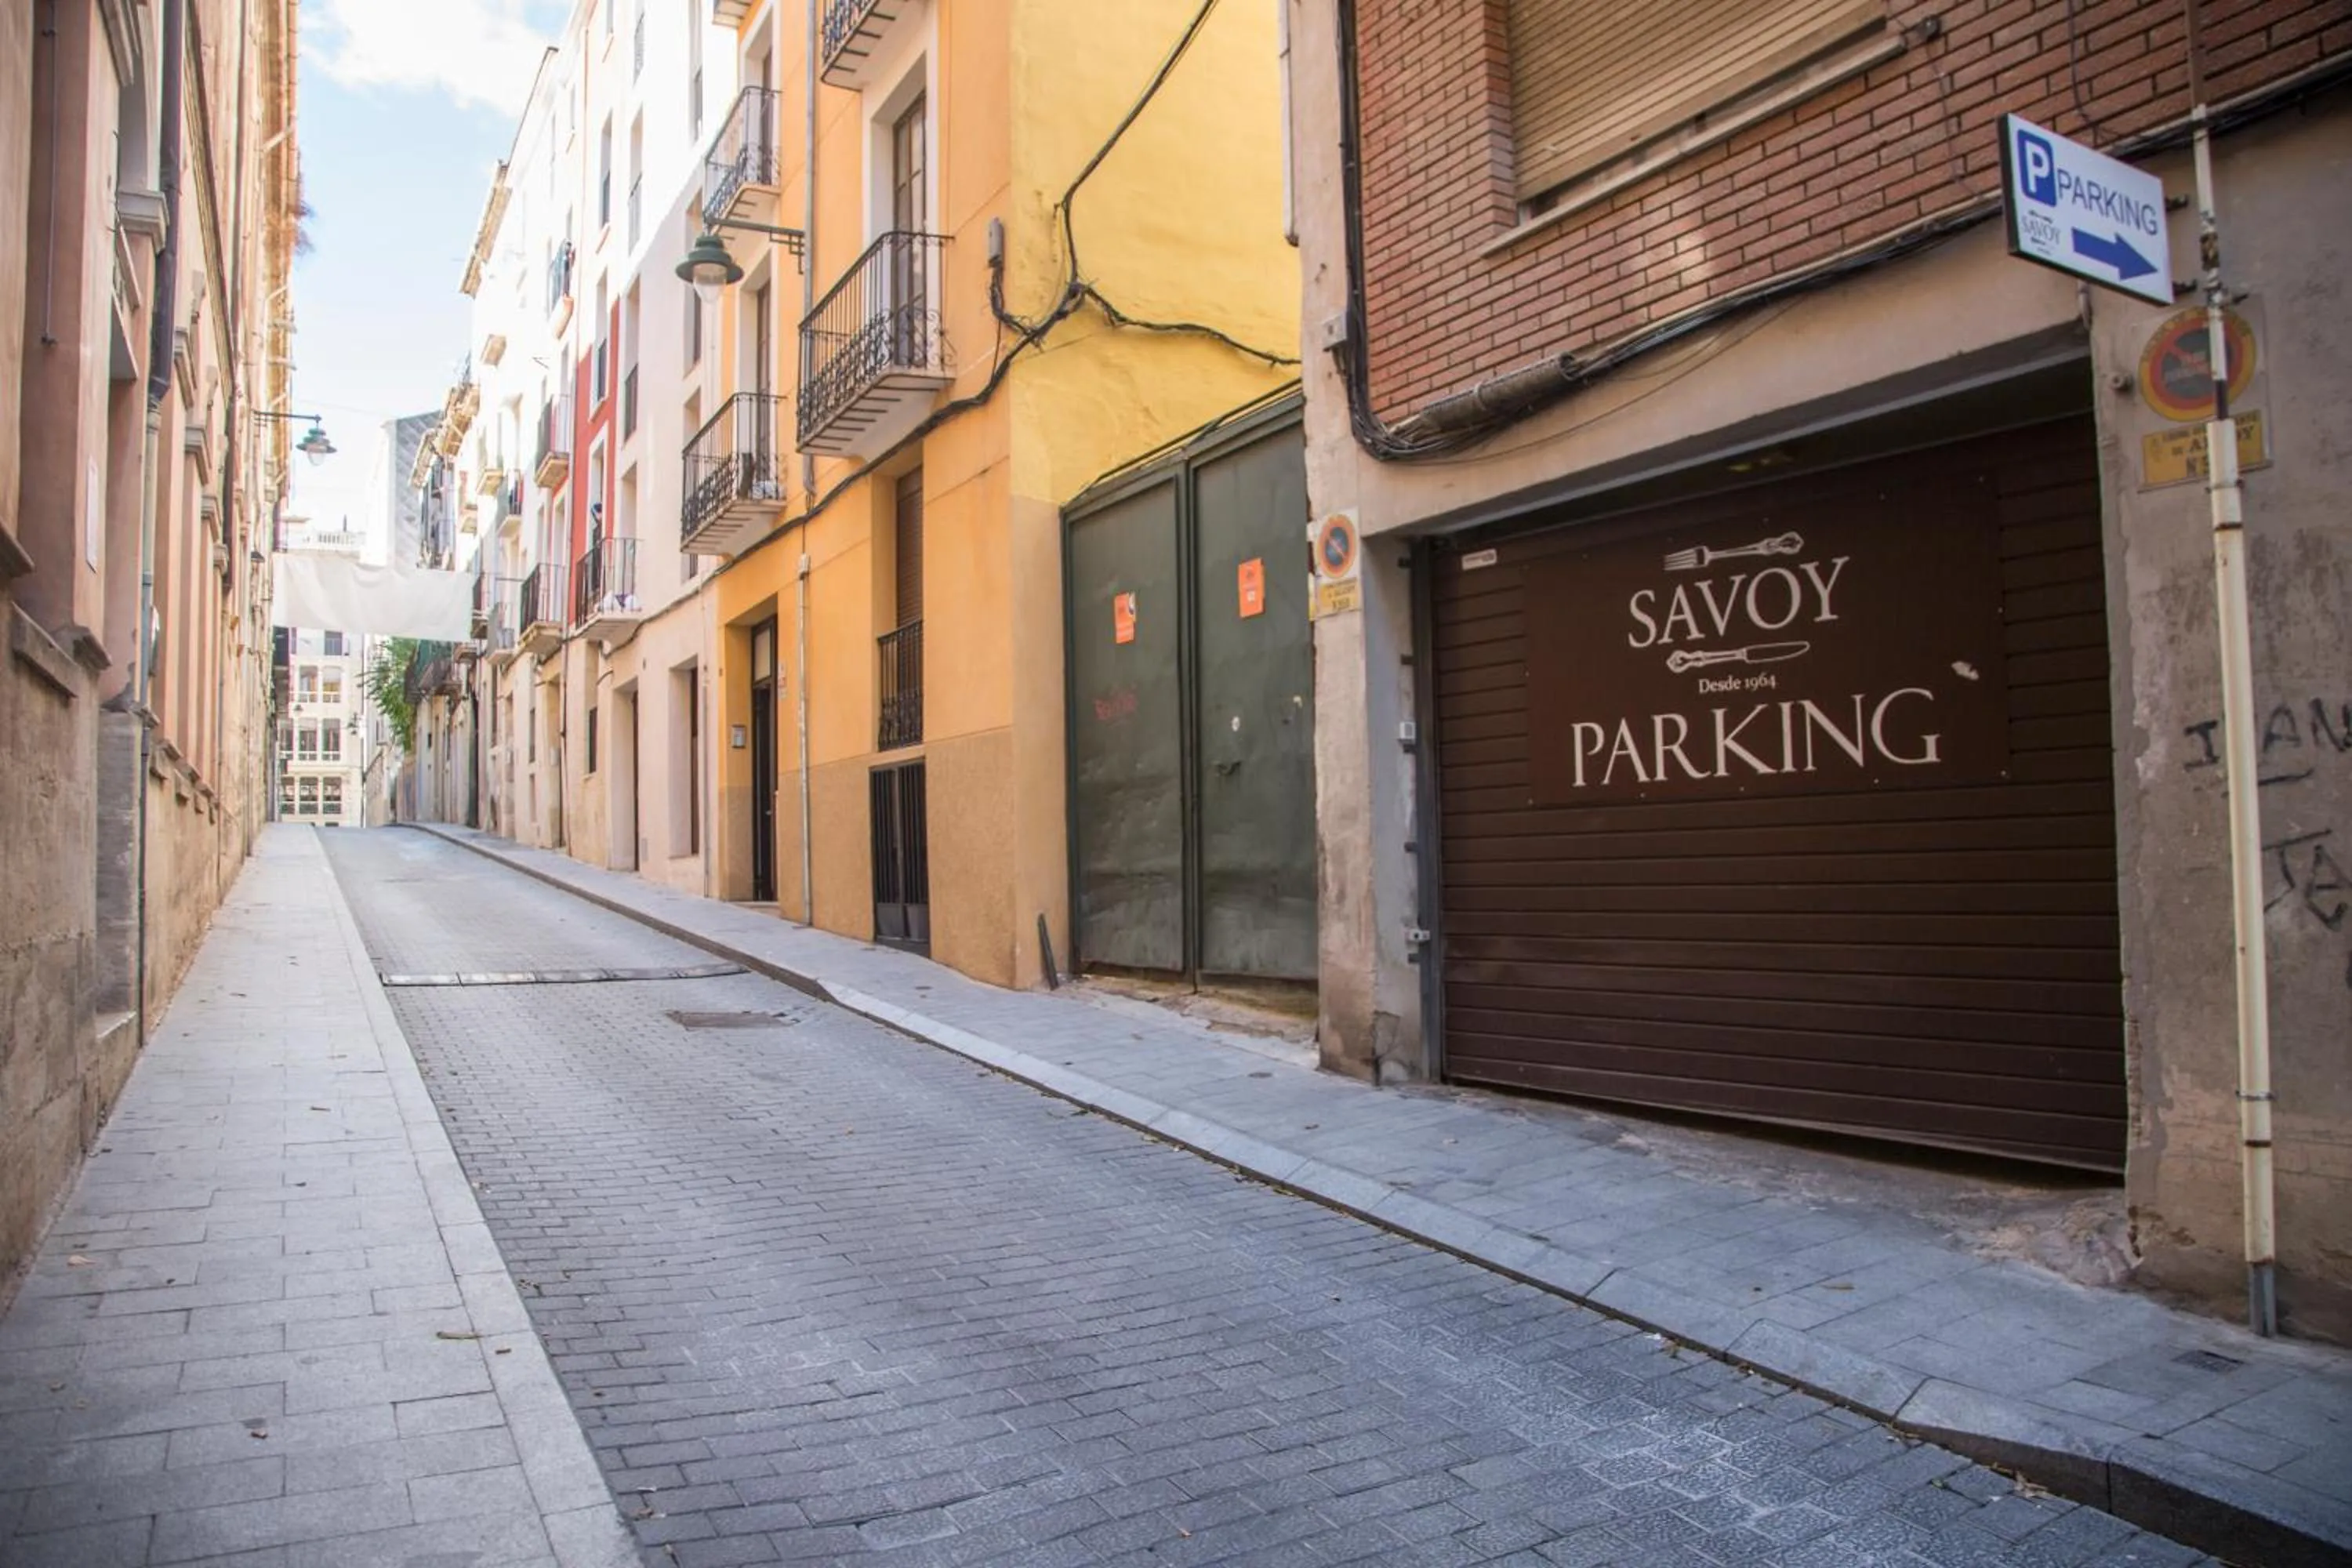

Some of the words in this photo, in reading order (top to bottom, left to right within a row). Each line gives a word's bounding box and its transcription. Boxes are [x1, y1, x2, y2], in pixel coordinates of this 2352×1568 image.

[2026, 142, 2050, 193] P
[2057, 168, 2158, 236] PARKING
[1628, 556, 1849, 648] SAVOY
[1699, 674, 1741, 694] Desde
[1744, 672, 1776, 692] 1964
[1570, 688, 1942, 786] PARKING
